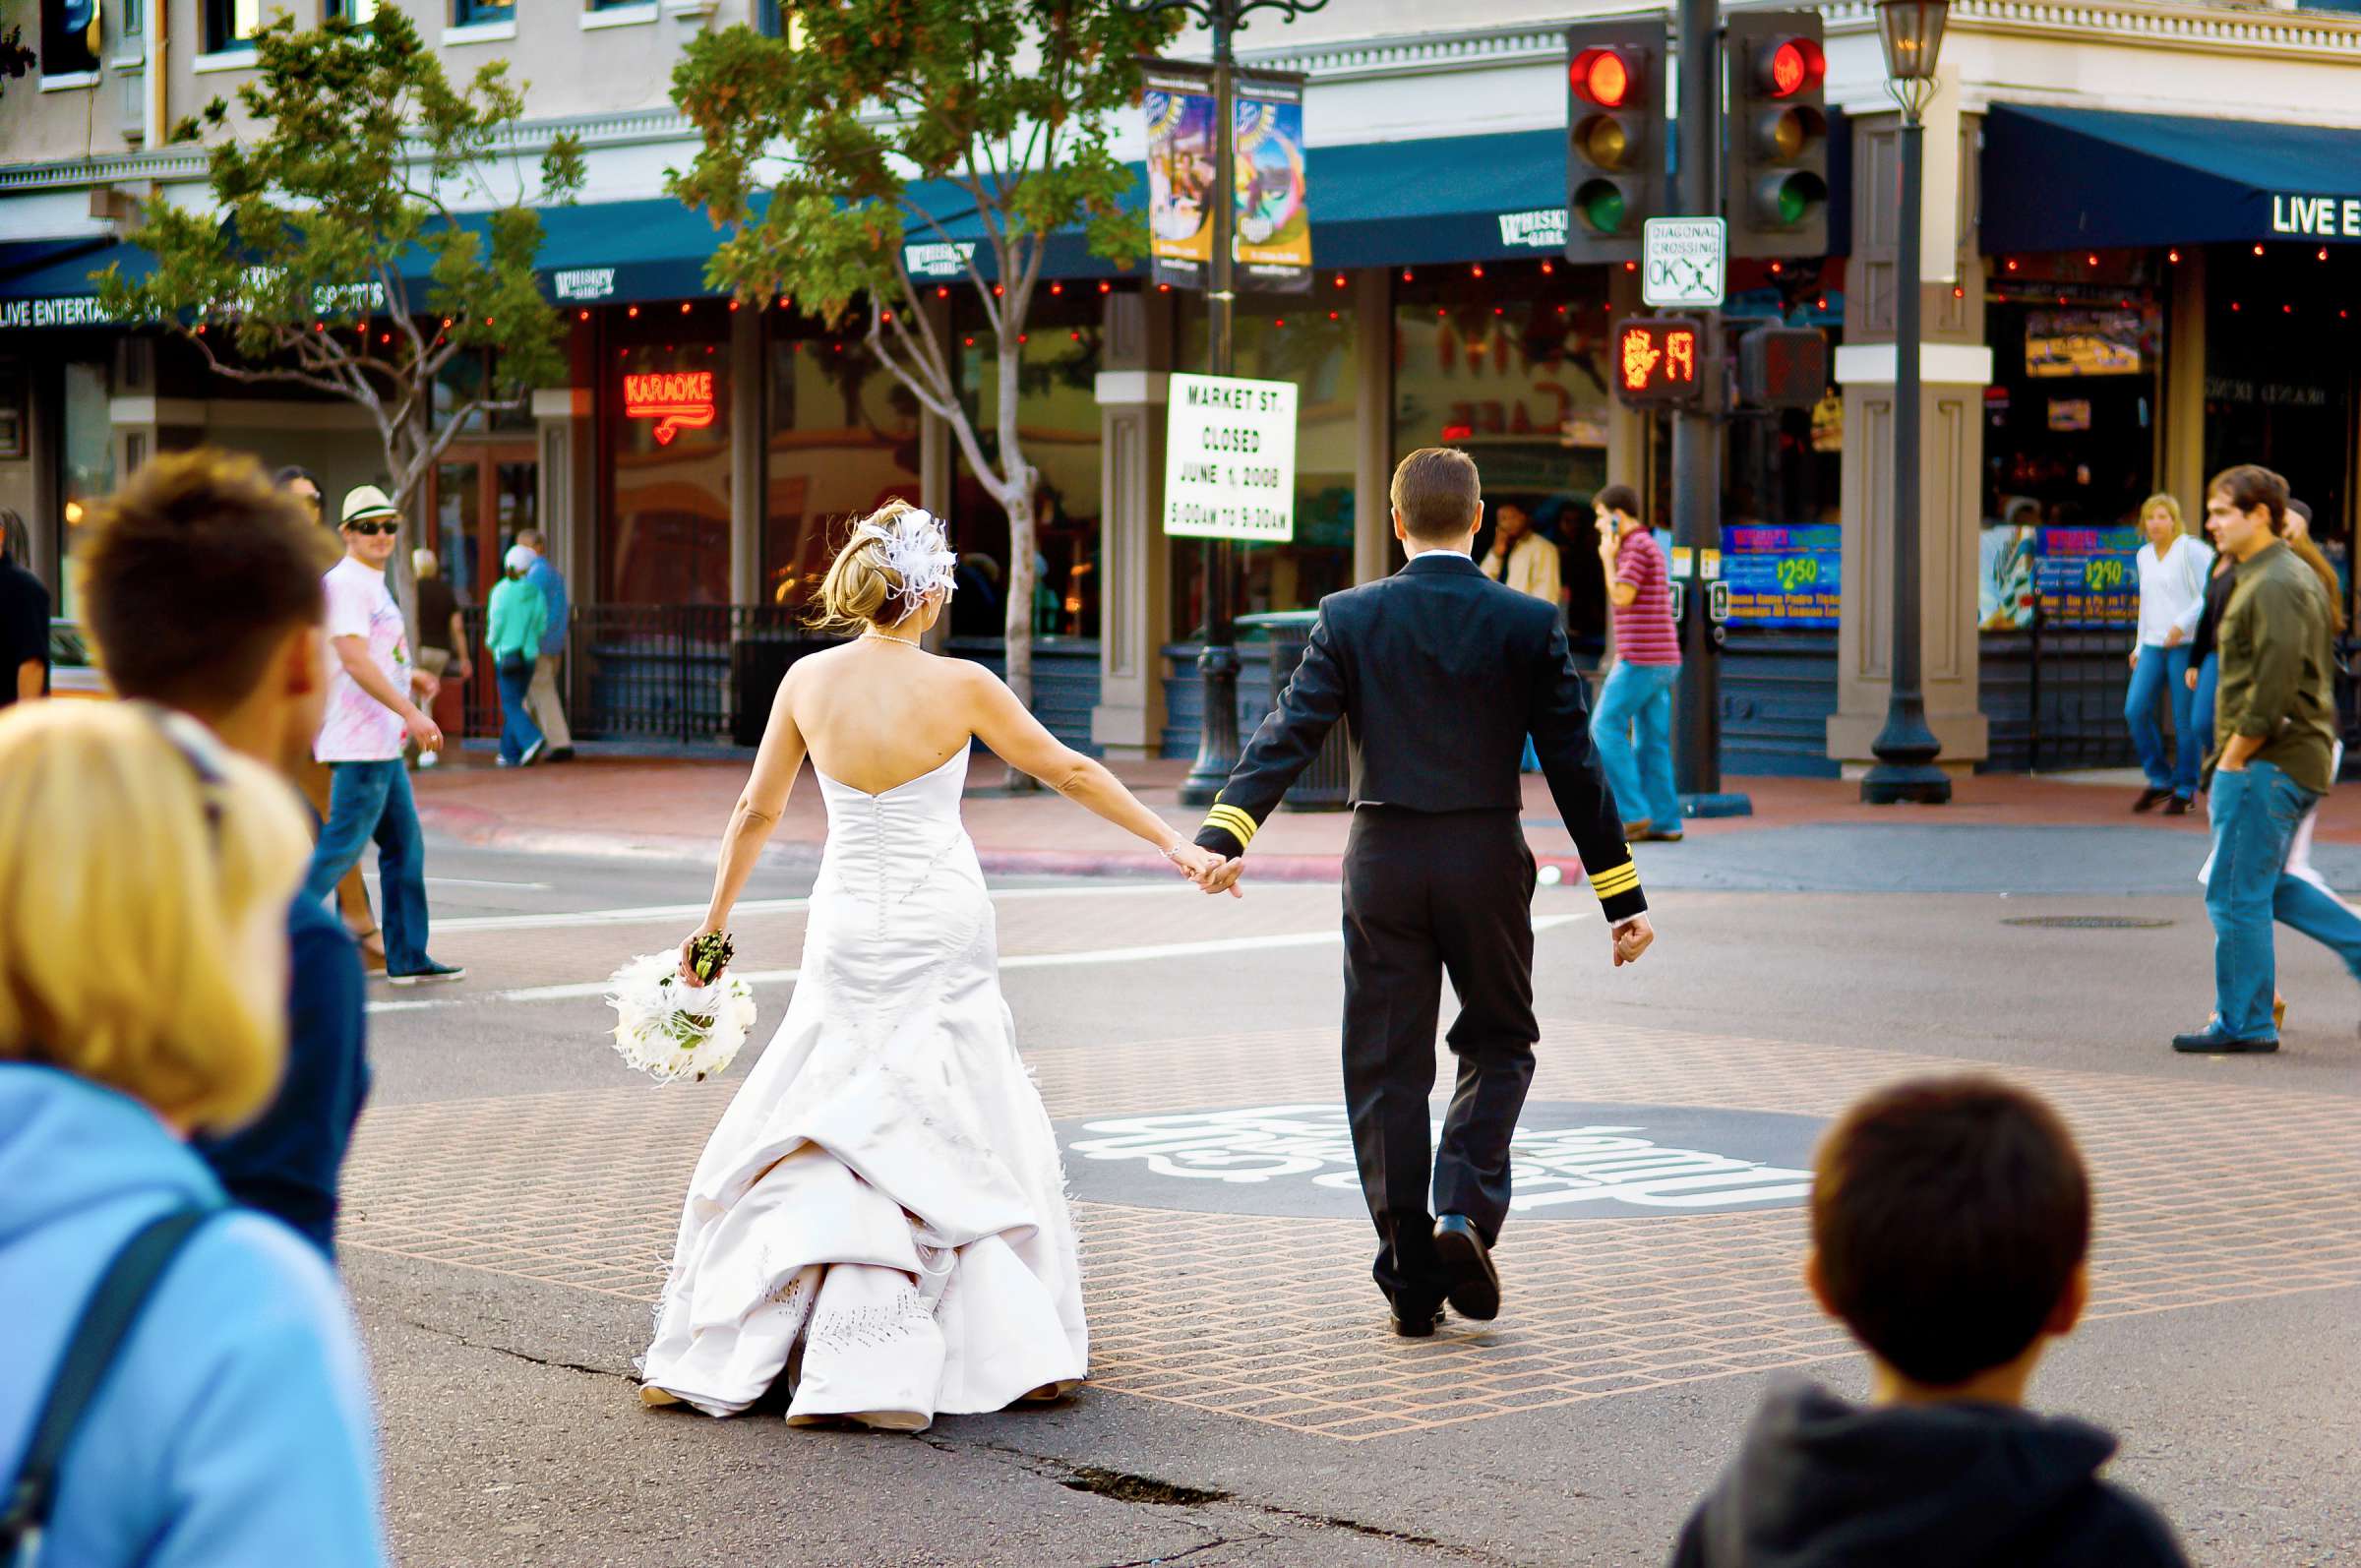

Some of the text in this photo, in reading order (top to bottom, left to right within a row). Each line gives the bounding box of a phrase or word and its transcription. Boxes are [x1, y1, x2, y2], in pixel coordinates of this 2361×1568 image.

[1498, 210, 1568, 246] WHISK
[2273, 196, 2335, 235] LIVE
[1652, 226, 1718, 238] DIAGONAL
[1652, 242, 1717, 254] CROSSING
[555, 269, 615, 298] WHISKEY
[1649, 259, 1680, 286] OK
[626, 373, 712, 403] KARAOKE
[1188, 385, 1284, 412] MARKET ST.
[1203, 425, 1260, 453] CLOSED
[1180, 462, 1219, 485] JUNE
[1243, 466, 1279, 489] 2008
[1220, 508, 1237, 528] TO
